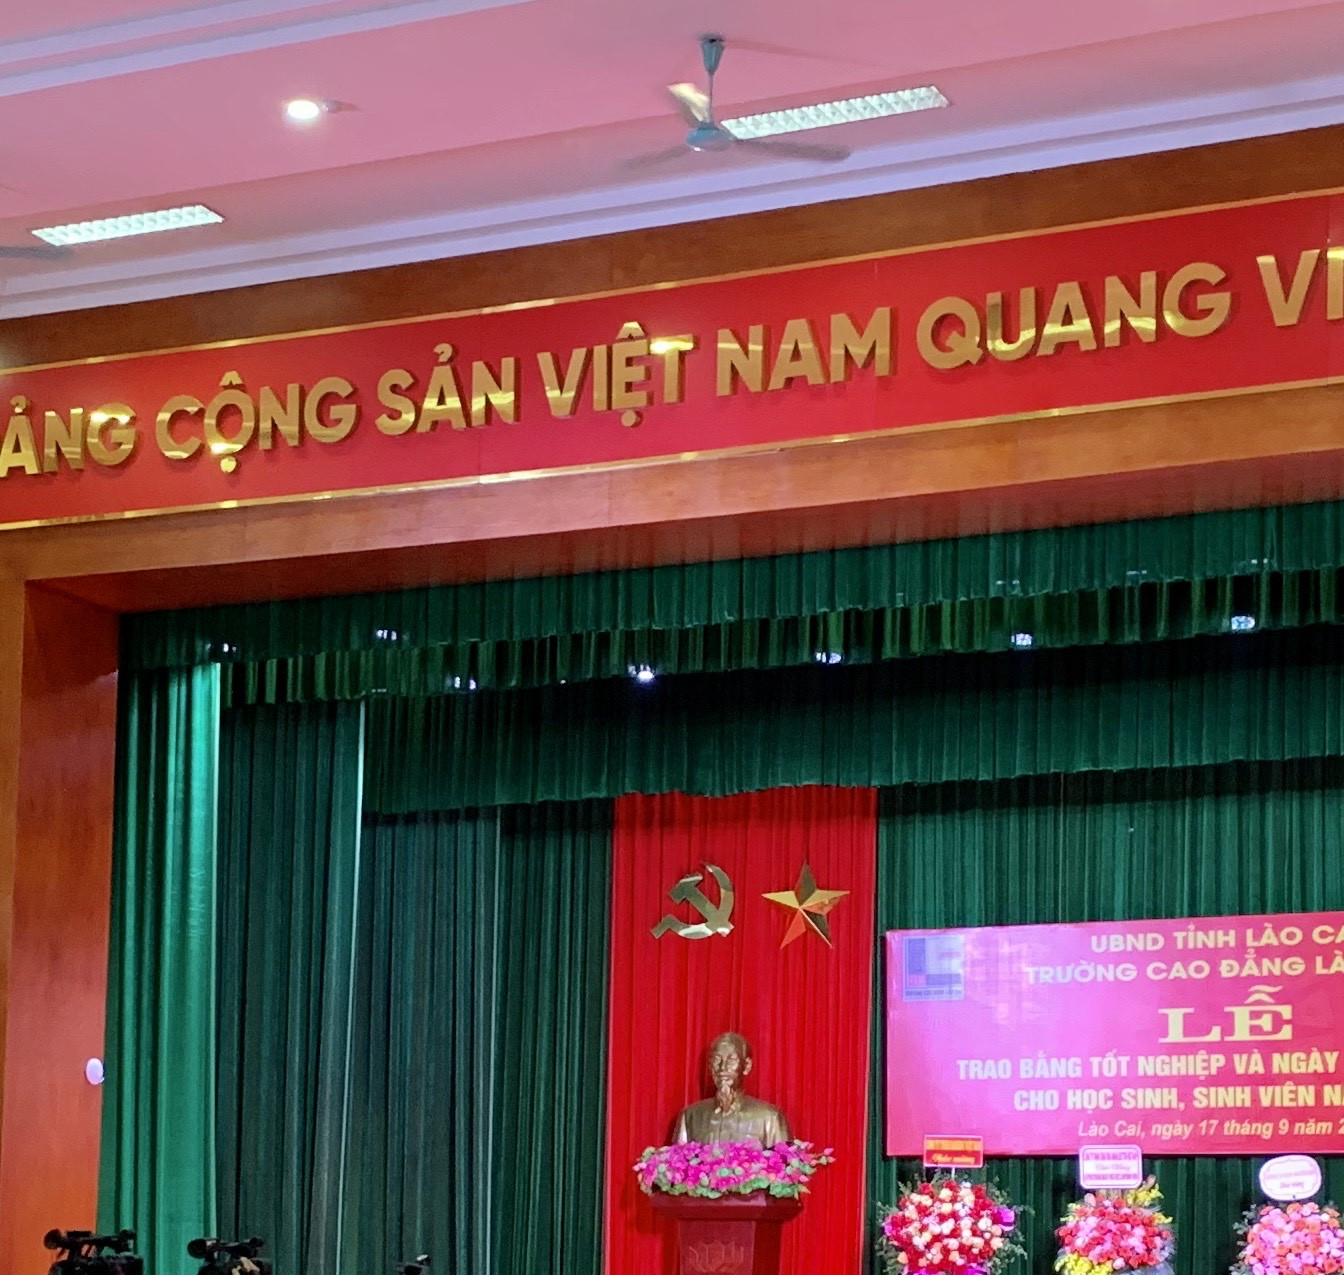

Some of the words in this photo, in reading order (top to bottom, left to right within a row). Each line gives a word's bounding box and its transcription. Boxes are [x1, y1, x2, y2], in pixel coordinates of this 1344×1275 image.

[156, 371, 357, 473] CỘNG
[375, 343, 521, 437] SẢN
[538, 321, 699, 427] VIỆT
[717, 306, 892, 397] NAM
[916, 262, 1231, 369] QUANG
[1091, 932, 1164, 953] UBND
[1173, 924, 1236, 950] TỈNH
[1246, 923, 1302, 947] LÀO
[1026, 960, 1138, 985] TRƯỜNG
[1147, 961, 1210, 980] CAO
[1219, 948, 1306, 978] ĐẲNG
[1157, 984, 1293, 1044] LỄ
[957, 1057, 1012, 1080] TRAO
[1019, 1050, 1082, 1079] BẰNG
[1090, 1048, 1131, 1078] TỐT
[1138, 1050, 1225, 1080] NGHIỆP
[1233, 1047, 1265, 1075] VÀ
[1272, 1047, 1339, 1074] NGÀY
[1014, 1089, 1059, 1111] CHO
[1067, 1089, 1114, 1115] HỌC
[1121, 1088, 1185, 1113] SINH,
[1193, 1086, 1251, 1109] SINH
[1258, 1082, 1315, 1108] VIÊN
[1078, 1119, 1109, 1138] Lào
[1113, 1120, 1146, 1140] Cai,
[1151, 1121, 1193, 1141] ngày
[1199, 1119, 1218, 1136] 17
[1223, 1118, 1273, 1140] tháng
[1278, 1118, 1290, 1135] 9
[1293, 1118, 1332, 1135] năm
